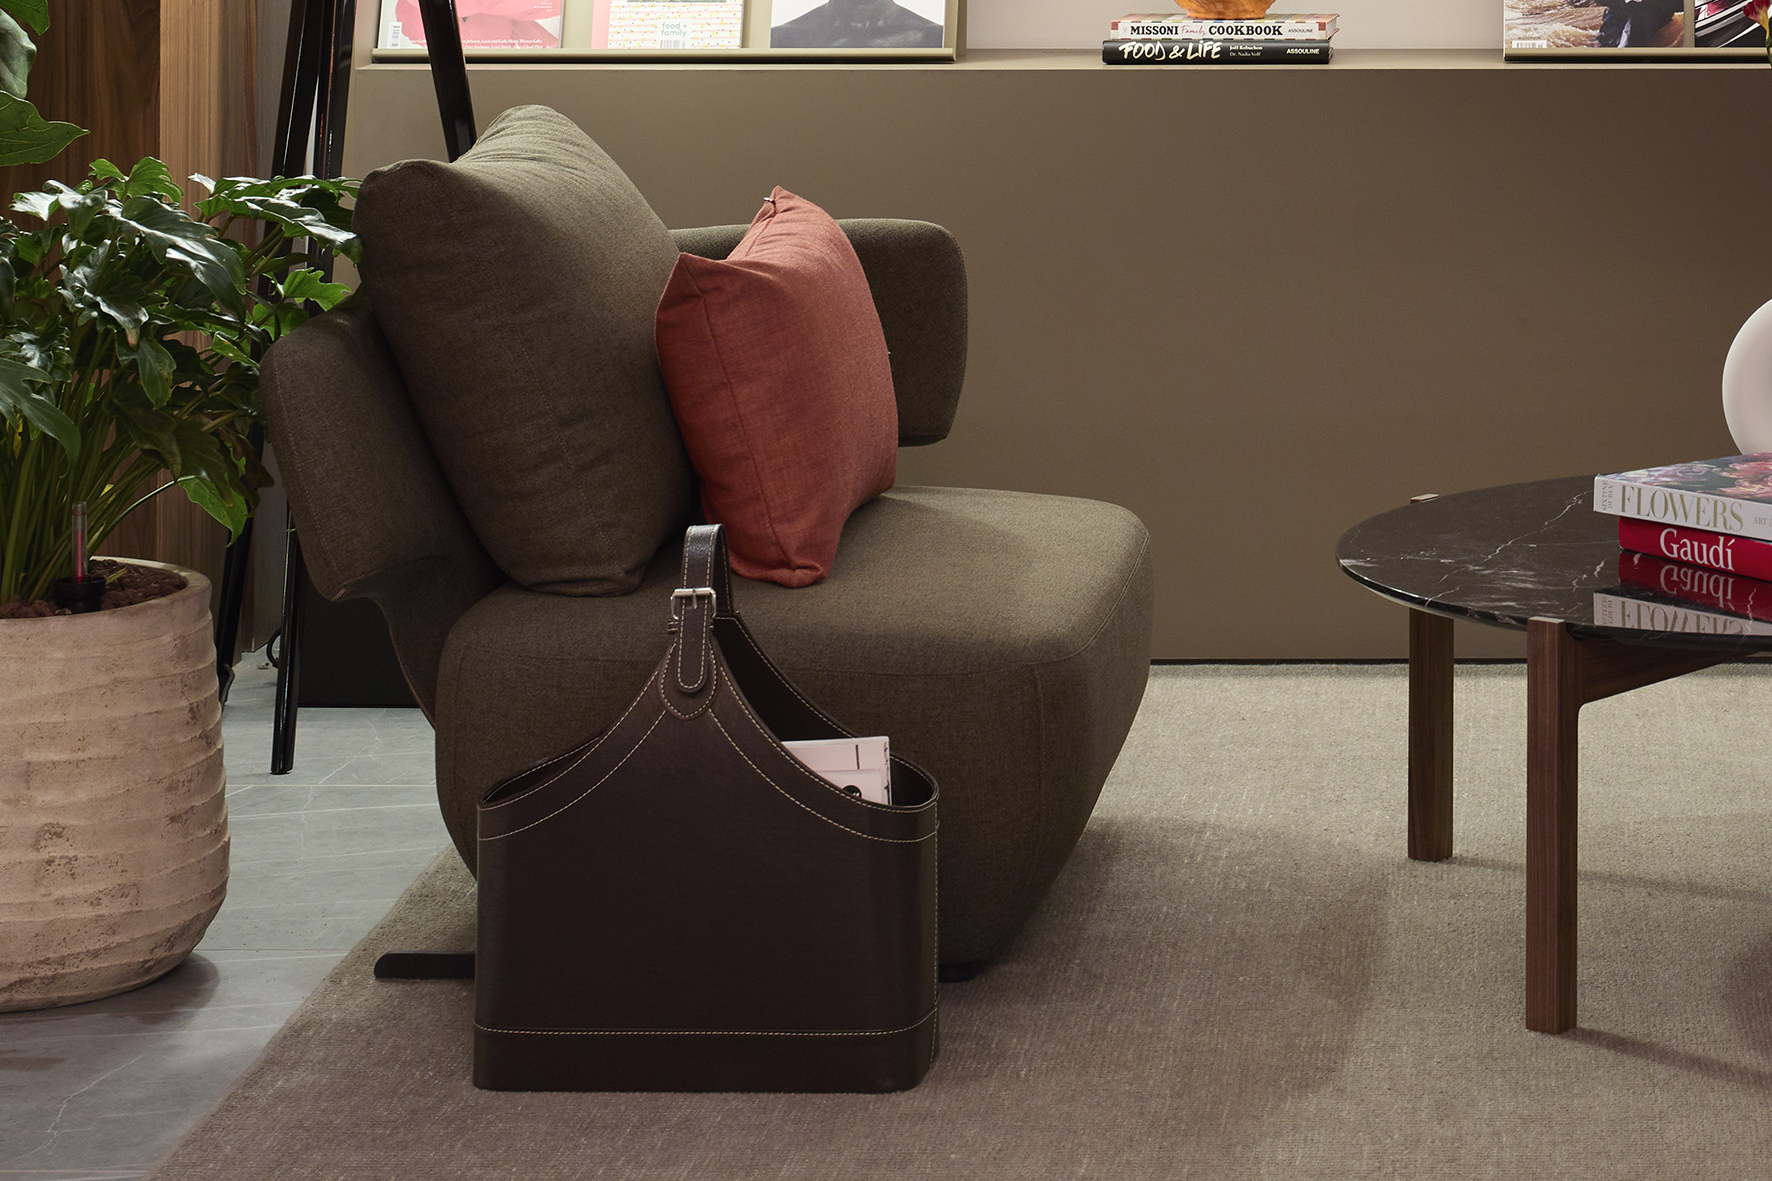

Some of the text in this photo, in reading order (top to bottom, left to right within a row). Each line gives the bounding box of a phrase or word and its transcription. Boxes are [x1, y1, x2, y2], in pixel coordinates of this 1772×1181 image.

[661, 29, 687, 38] family
[1130, 25, 1179, 35] MISSONI
[1208, 25, 1283, 36] COOKBOOK
[1118, 41, 1166, 61] FOOD
[1168, 44, 1185, 57] &
[1620, 485, 1744, 532] FLOWERS
[1753, 516, 1767, 525] ART
[1660, 527, 1735, 571] Gaudí
